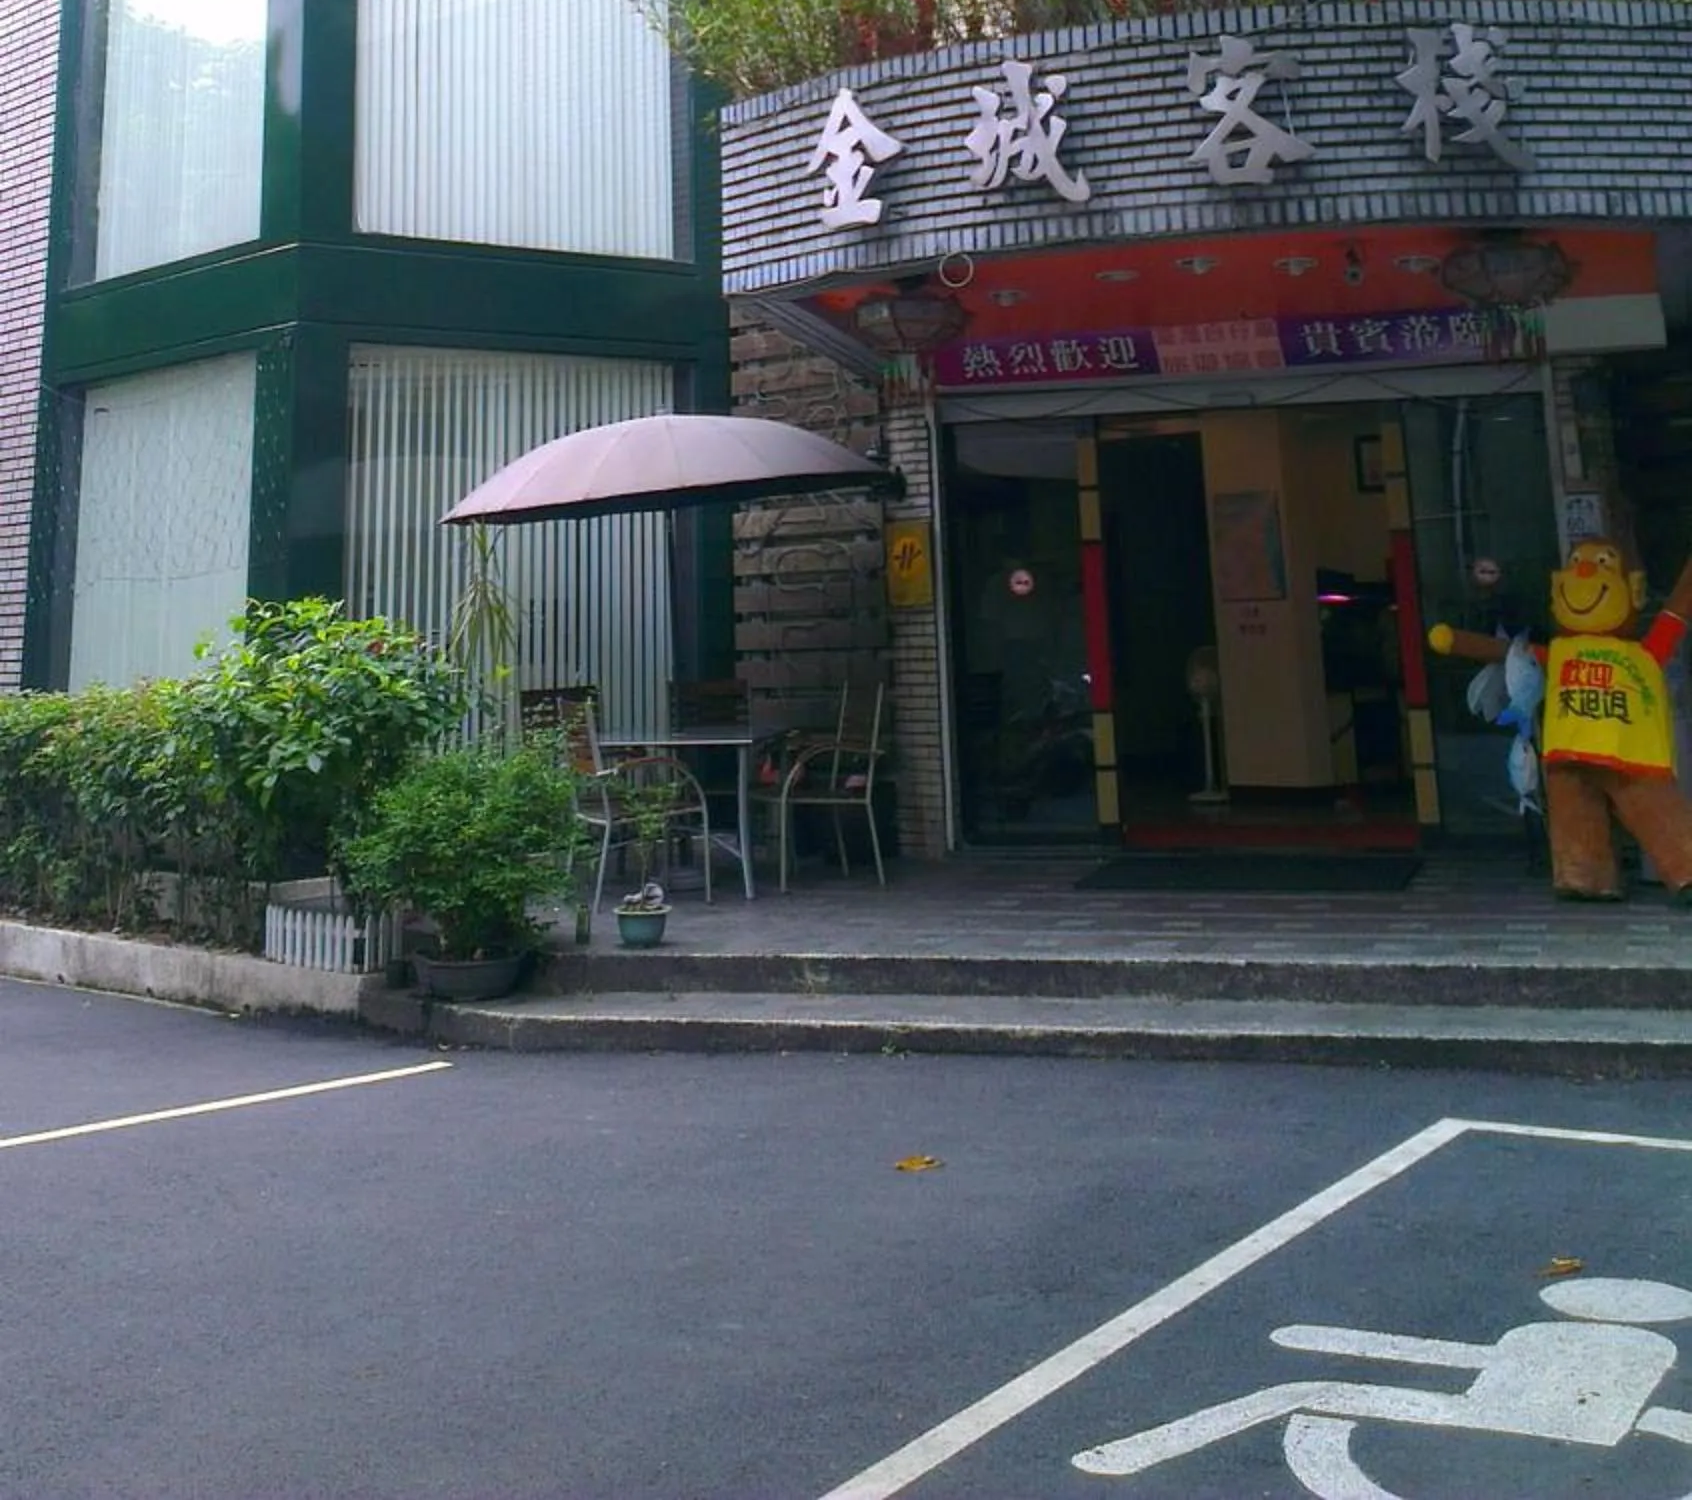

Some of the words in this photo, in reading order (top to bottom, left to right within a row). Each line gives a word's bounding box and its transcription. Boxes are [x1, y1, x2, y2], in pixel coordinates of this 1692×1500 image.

[808, 23, 1536, 227] 金城客棧
[963, 336, 1140, 379] 熱烈歡迎
